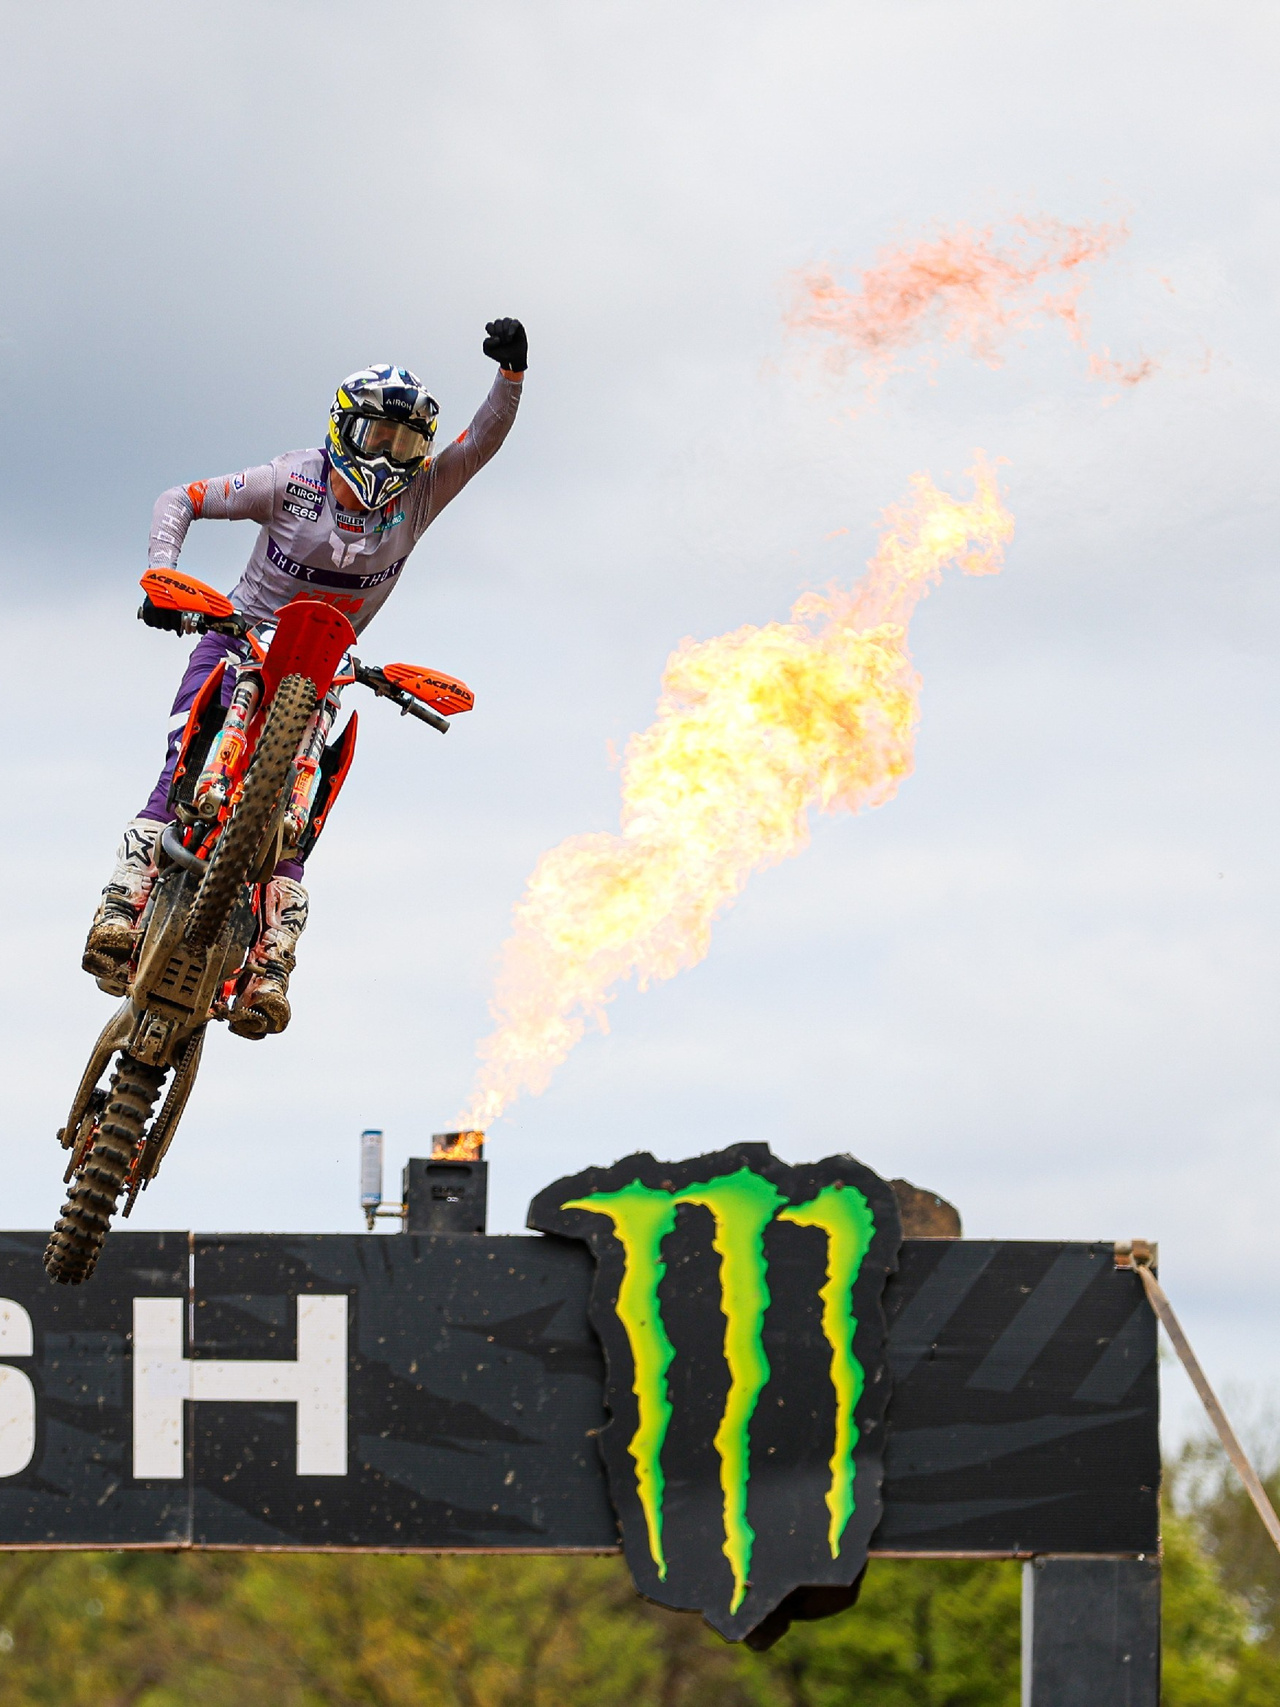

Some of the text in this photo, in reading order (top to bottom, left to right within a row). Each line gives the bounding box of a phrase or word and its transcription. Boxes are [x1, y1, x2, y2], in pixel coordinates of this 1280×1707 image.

[385, 397, 413, 411] AIROH
[288, 485, 322, 504] AIROH
[283, 503, 318, 521] JE68
[147, 573, 197, 595] ACERBIS
[422, 677, 472, 701] ACERBIS
